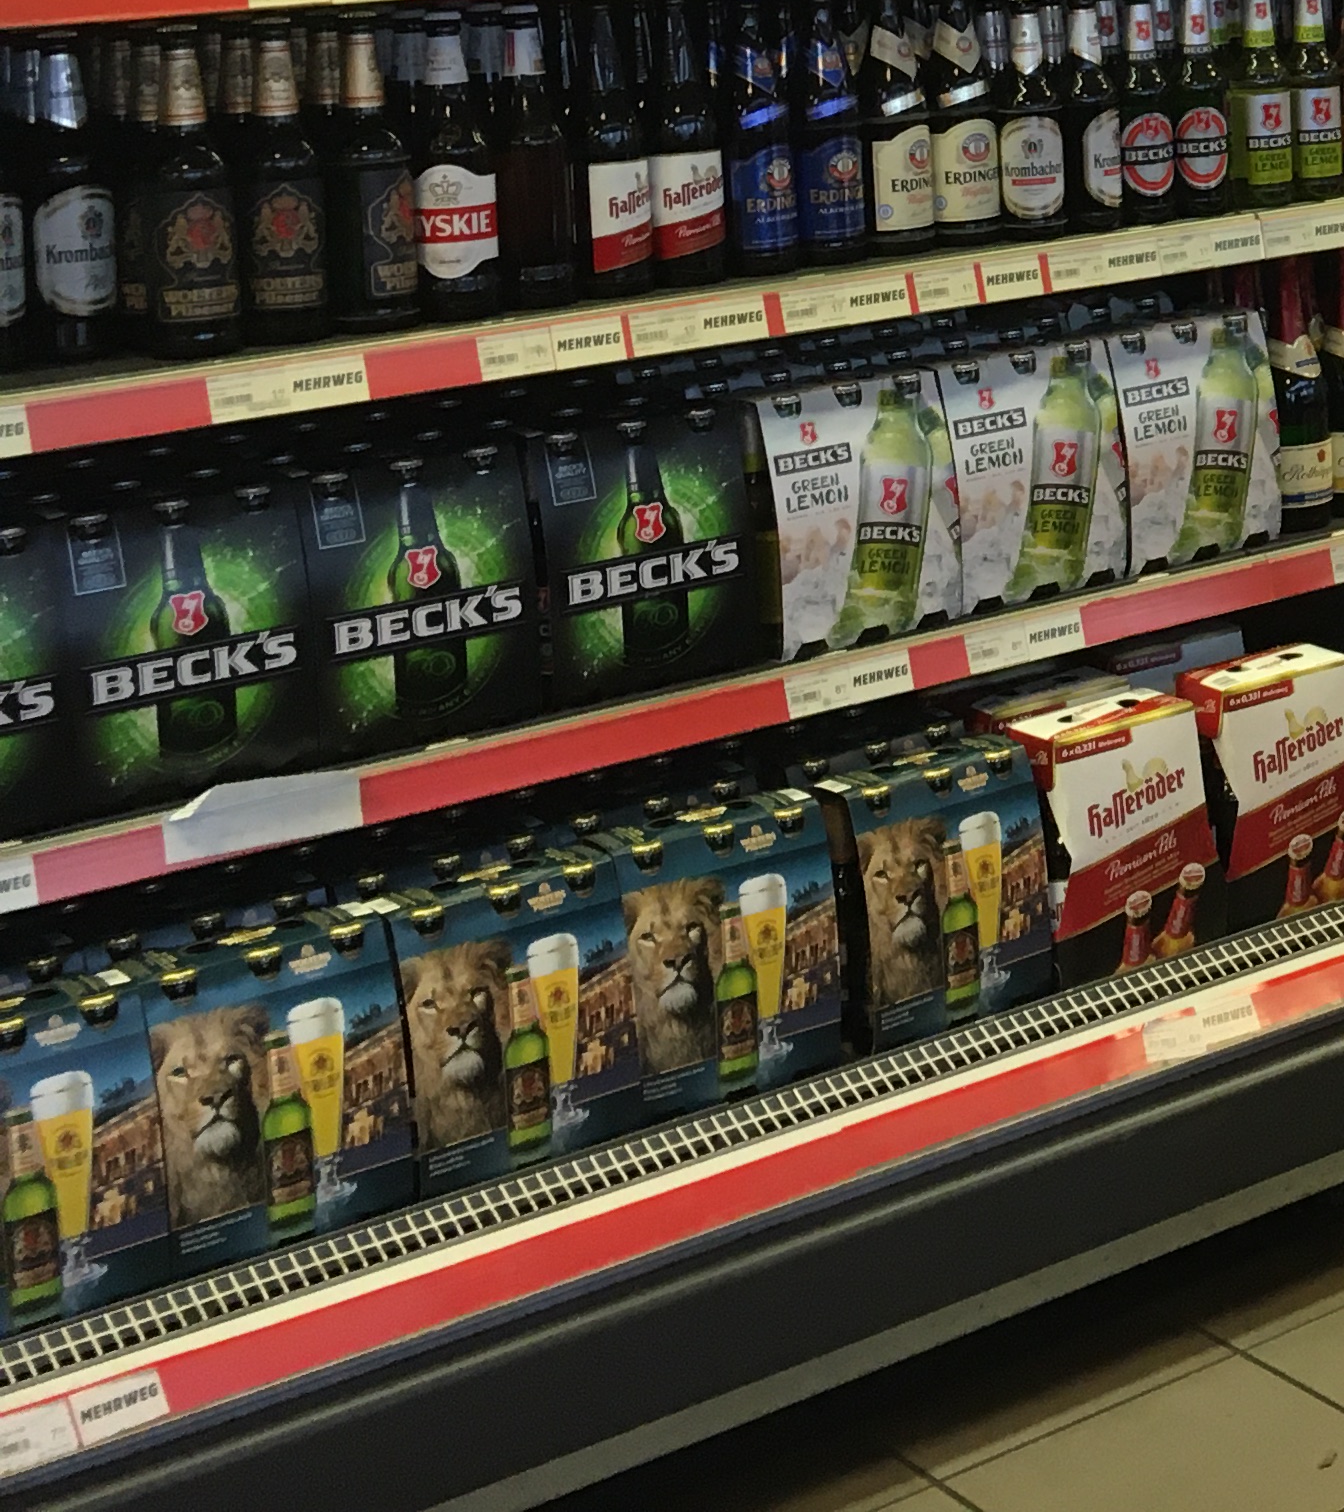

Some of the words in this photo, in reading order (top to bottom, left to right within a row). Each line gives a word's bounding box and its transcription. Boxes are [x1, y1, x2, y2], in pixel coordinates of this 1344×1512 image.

[1125, 145, 1174, 163] BECK'S
[1248, 135, 1292, 150] BECK'S
[1214, 235, 1261, 252] MEHRWEG
[849, 289, 905, 308] MEHRWEG
[703, 310, 763, 330] MEHRWEG
[557, 331, 621, 352] MEHRWEG
[293, 371, 364, 392] MEHRWEG
[1124, 380, 1189, 407] BECK'S
[957, 410, 1026, 437] BECK'S
[1137, 406, 1181, 427] GREEN
[1133, 418, 1188, 443] LEMON
[969, 436, 1017, 460] GREEN
[777, 447, 851, 474] BECK'S
[963, 450, 1025, 477] LEMON
[1196, 451, 1247, 469] BECK'S
[790, 473, 840, 496] GREEN
[785, 487, 849, 515] LEMON
[859, 523, 922, 545] BECK'S
[567, 537, 740, 607] BECK'S
[333, 586, 522, 656] BECK'S
[1029, 622, 1080, 645] MEHRWEG
[92, 630, 298, 706] BECK'S
[80, 1381, 159, 1426] MEHRWEG
